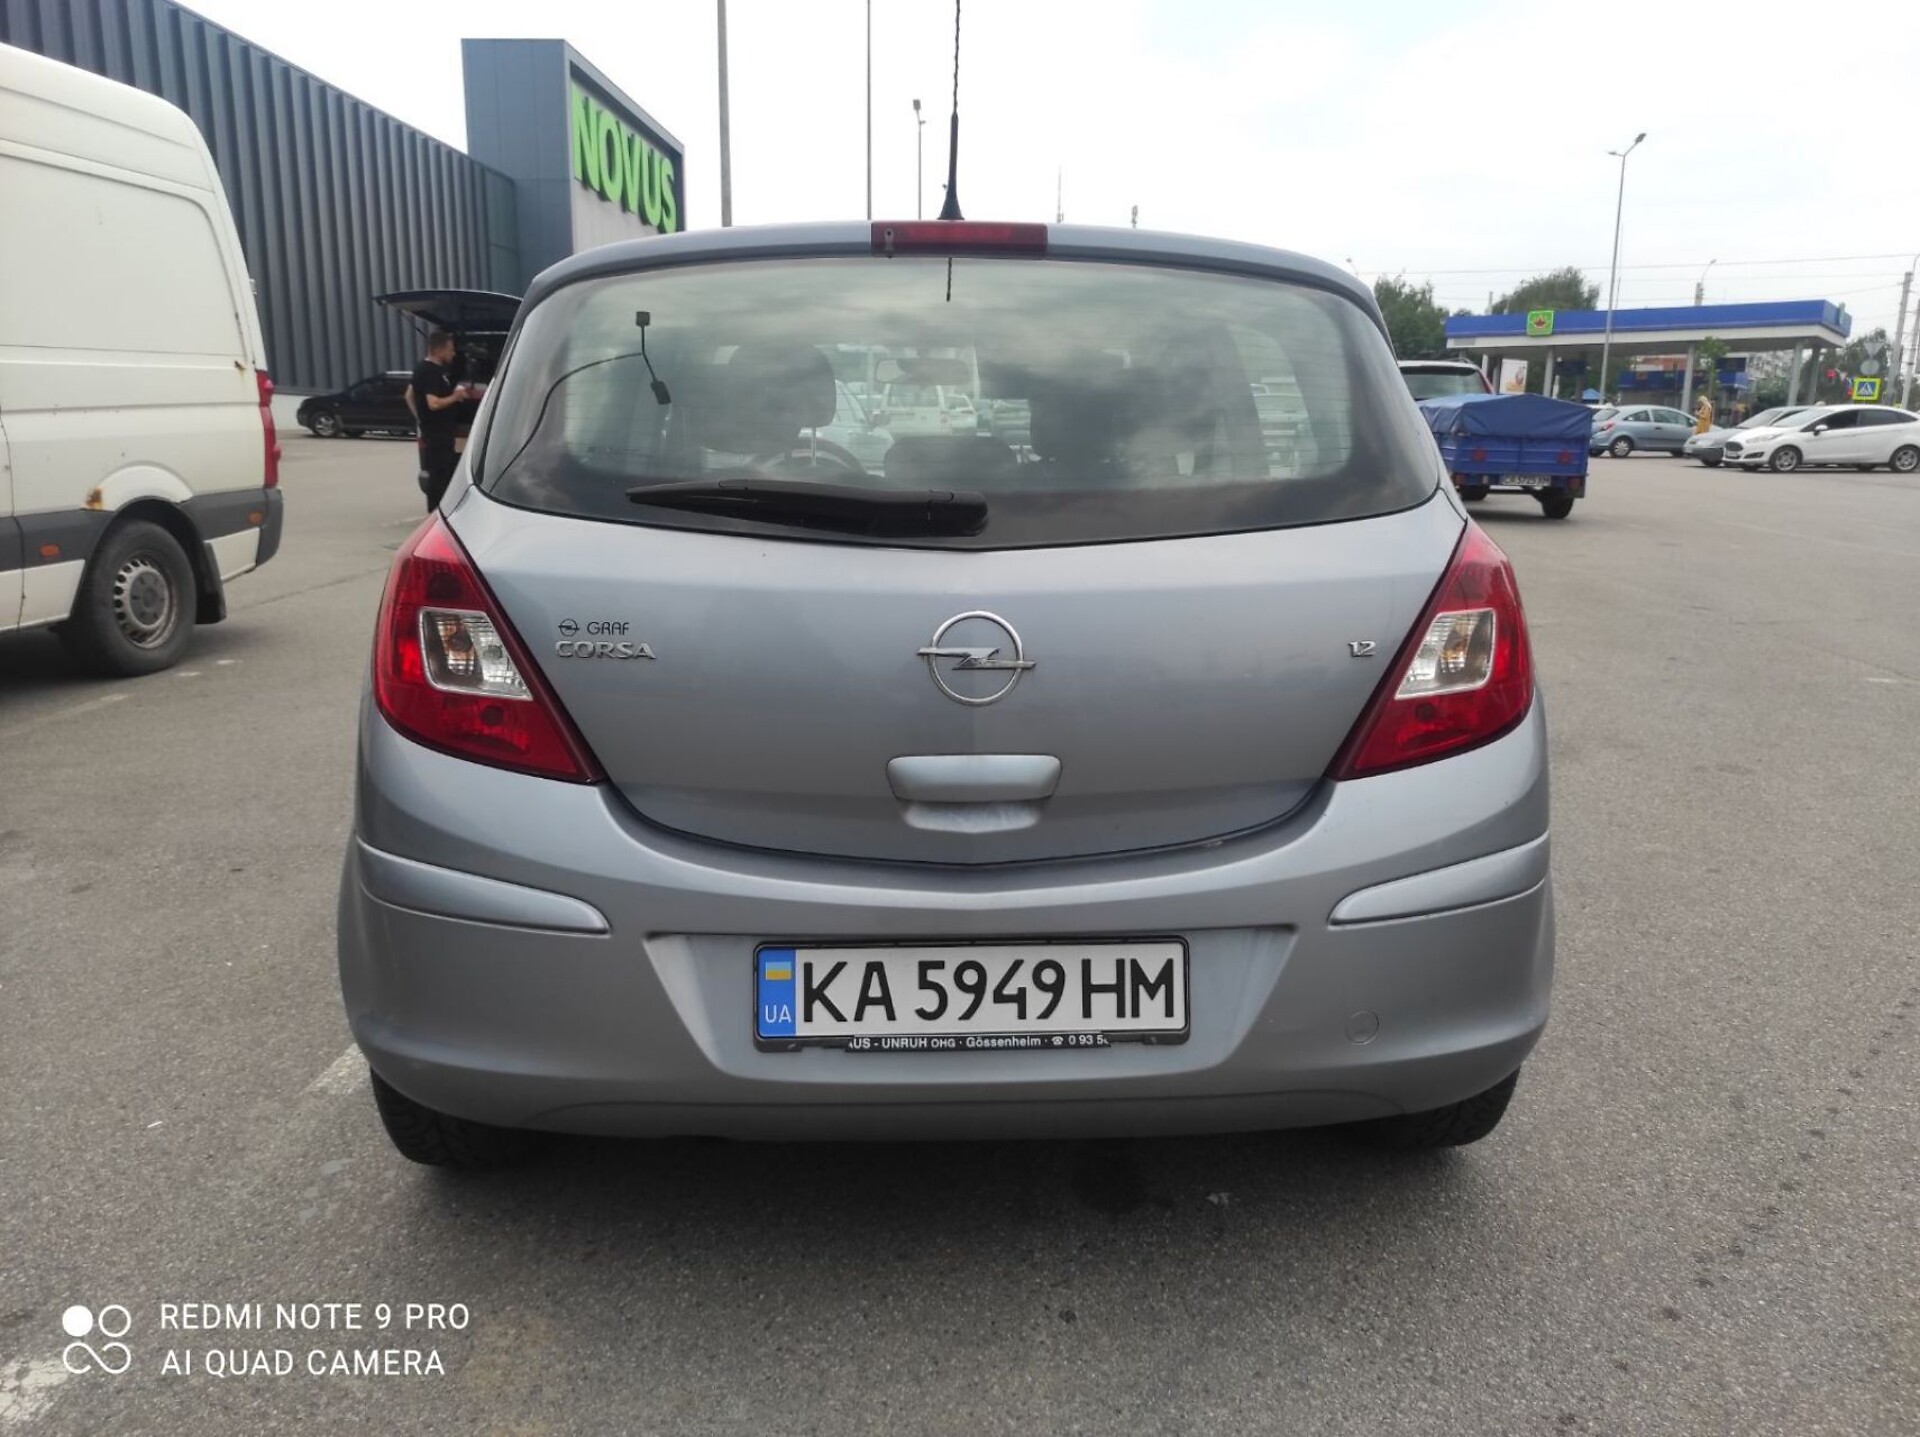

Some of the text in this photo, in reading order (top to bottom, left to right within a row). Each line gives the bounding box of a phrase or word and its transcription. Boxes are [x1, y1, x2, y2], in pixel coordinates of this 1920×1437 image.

[571, 81, 677, 234] NOVUS
[587, 621, 630, 636] GRAF
[556, 641, 657, 660] CORSA
[803, 958, 1174, 1022] KA 5949 HM
[764, 1005, 792, 1023] UA
[881, 1037, 928, 1049] UNRUH
[930, 1038, 956, 1048] OHG
[965, 1035, 1041, 1048] Gössenheim
